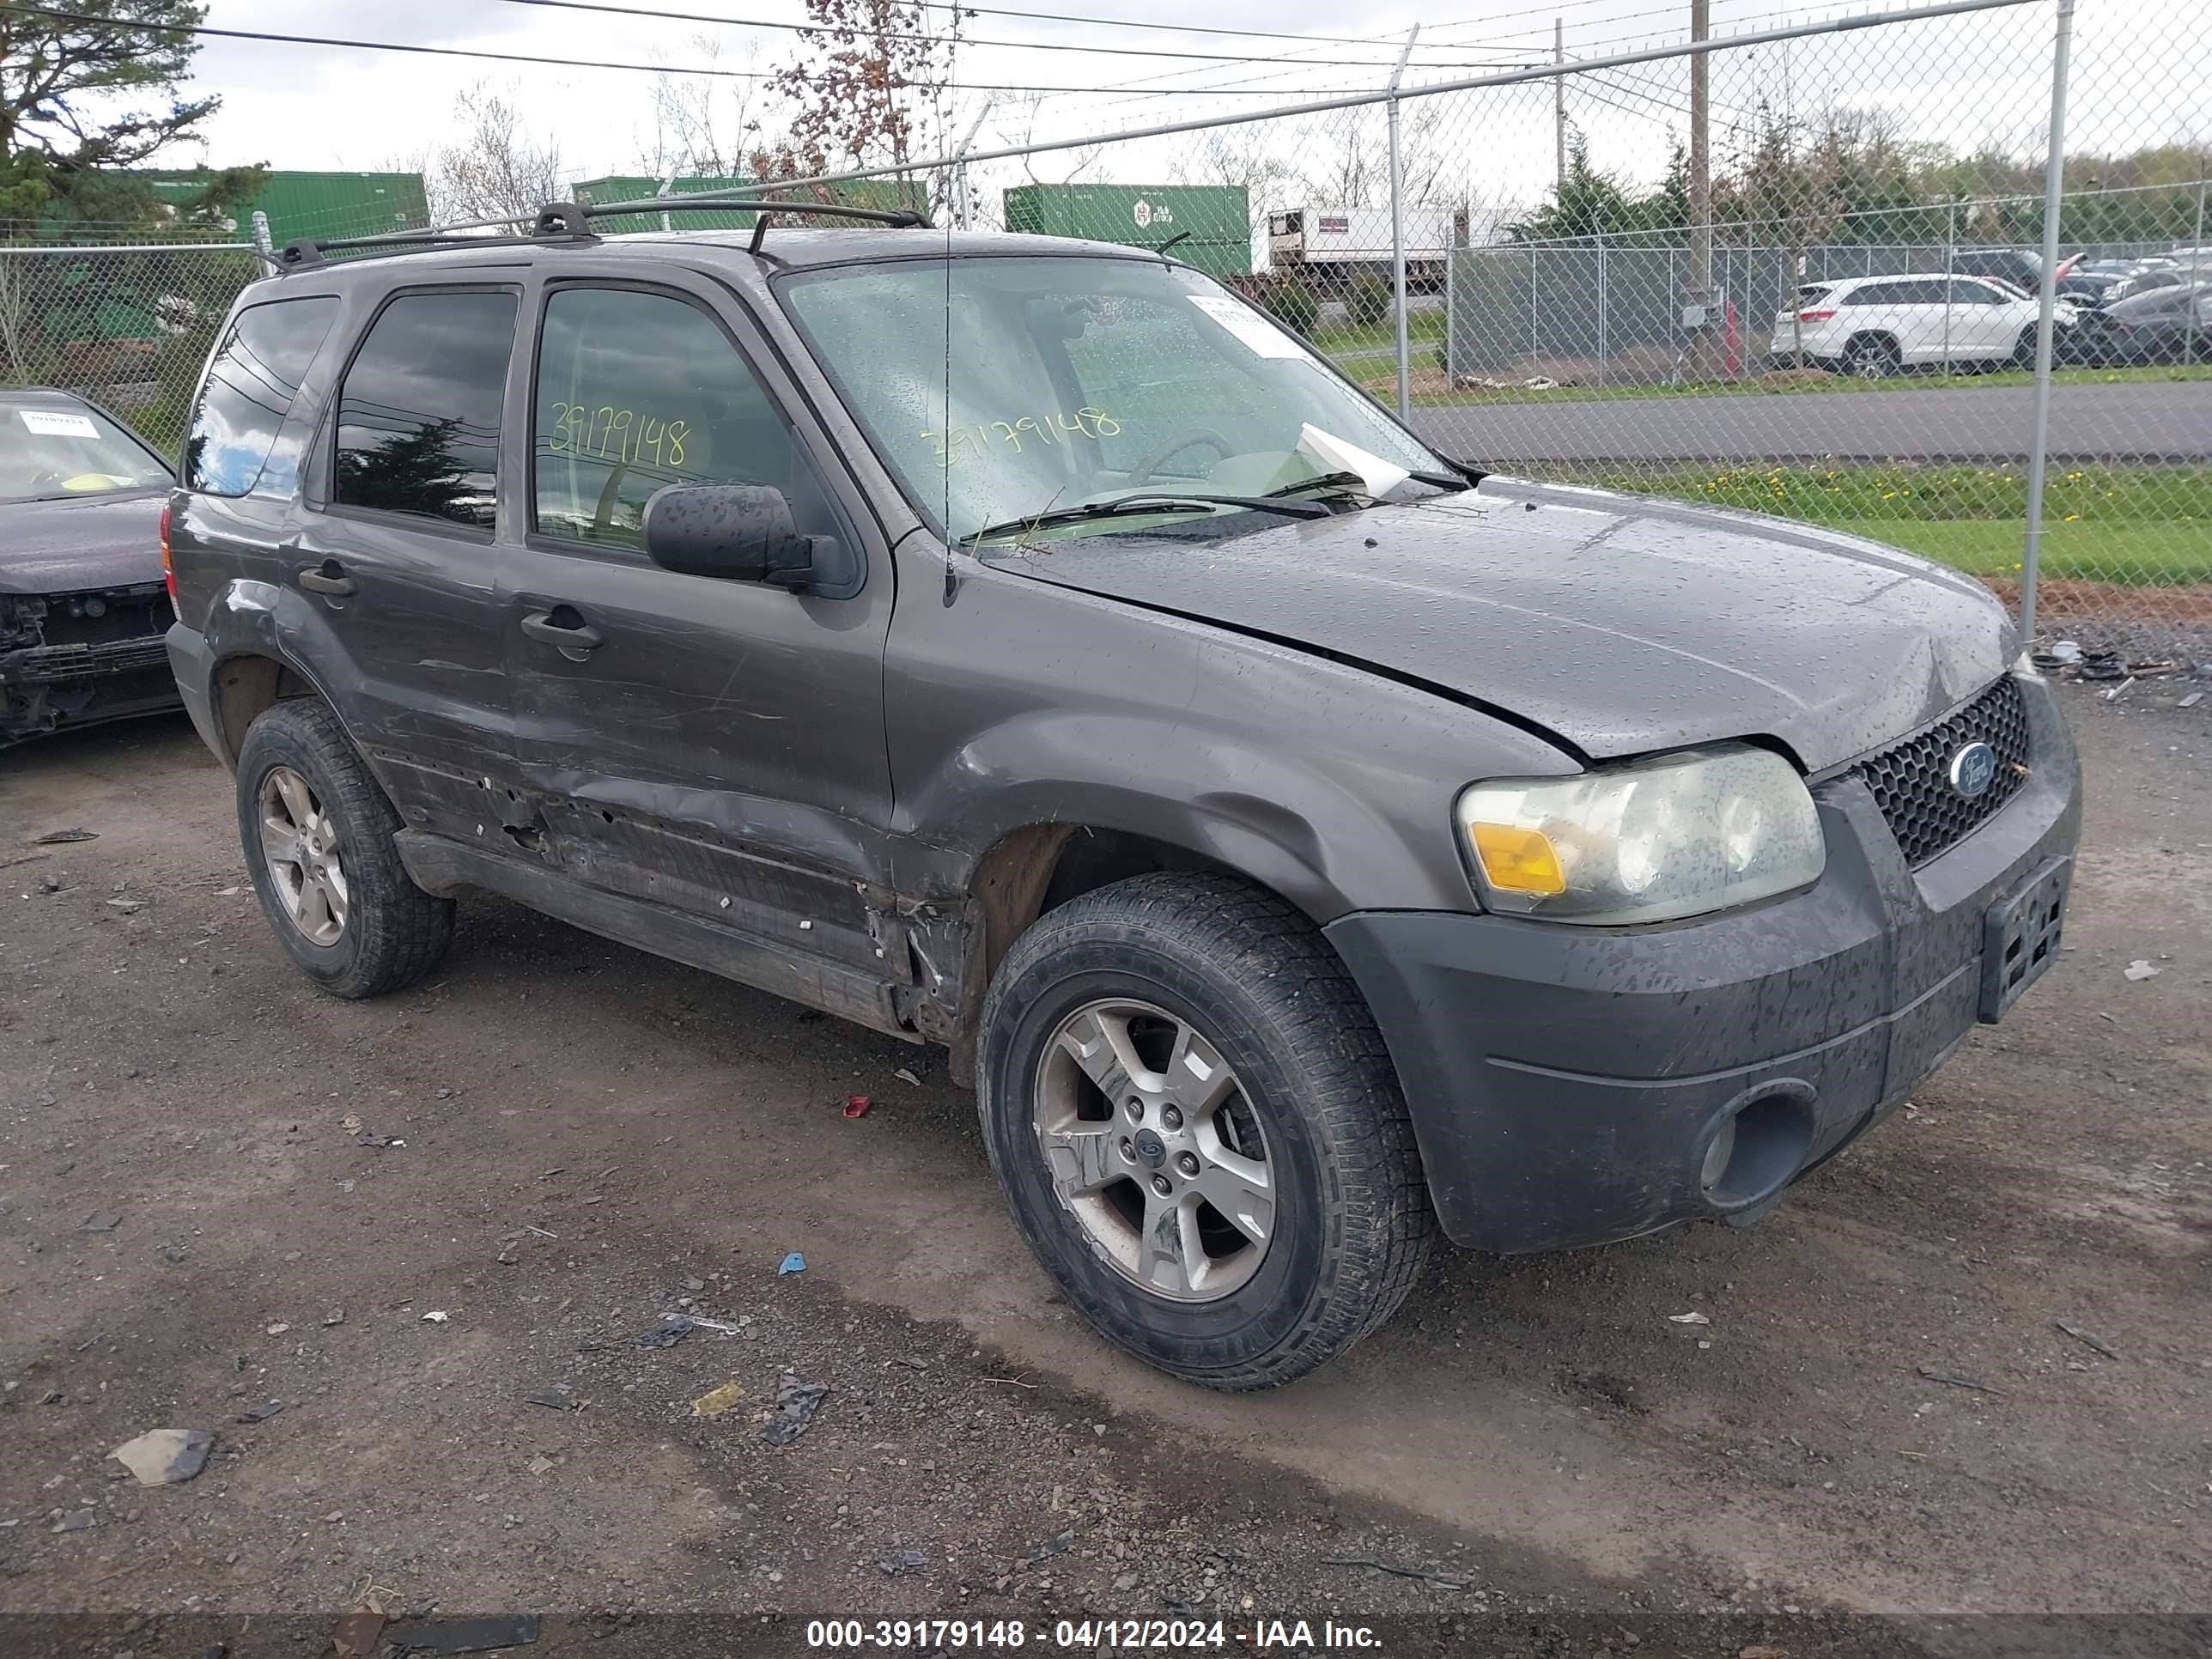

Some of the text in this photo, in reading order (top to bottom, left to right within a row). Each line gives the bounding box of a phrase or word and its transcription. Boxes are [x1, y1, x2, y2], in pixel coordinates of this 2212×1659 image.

[549, 401, 692, 467] 39179148
[920, 406, 1121, 468] 39179148
[1964, 752, 1989, 788] Ford
